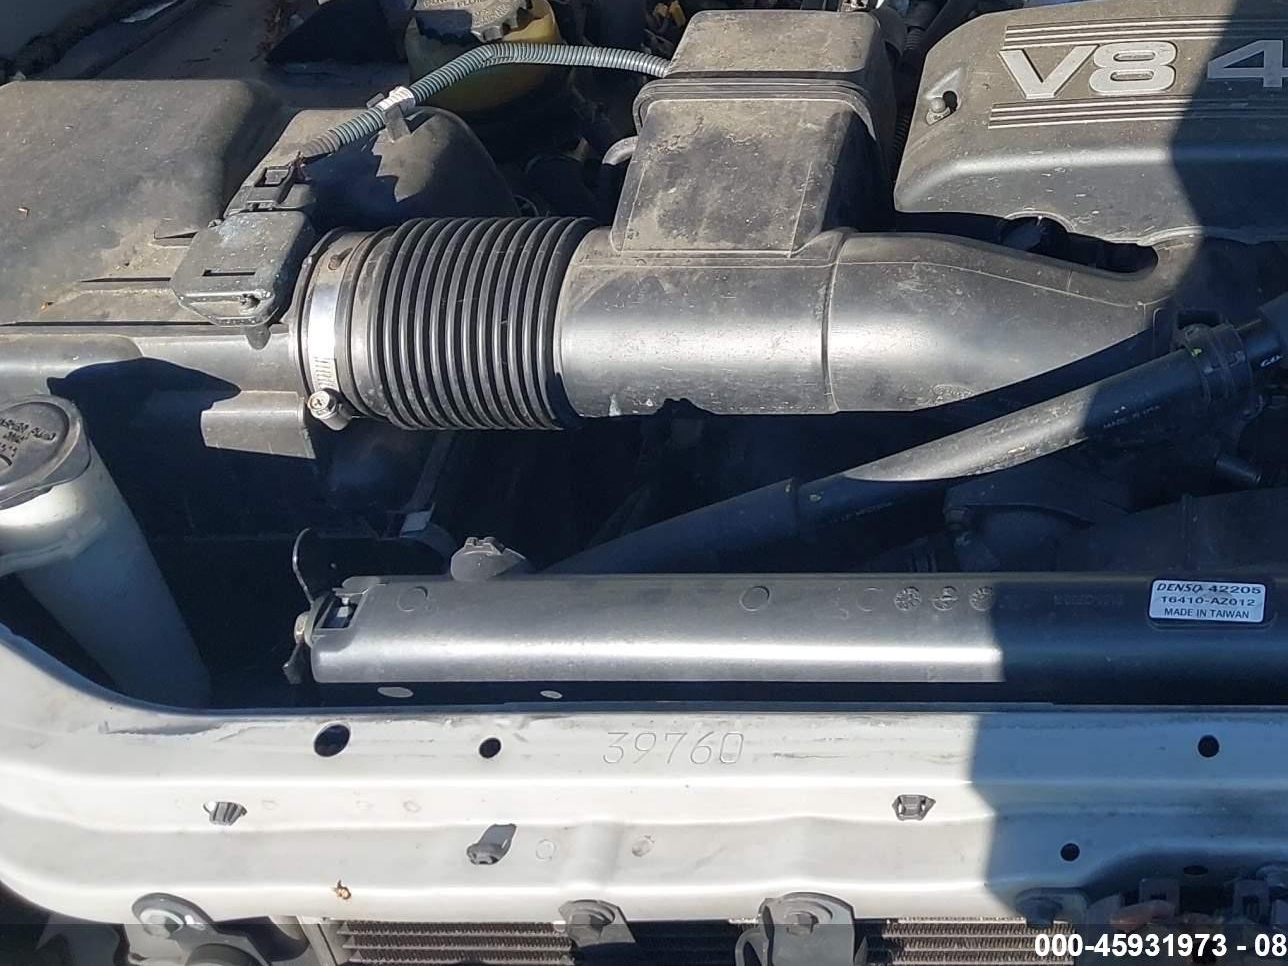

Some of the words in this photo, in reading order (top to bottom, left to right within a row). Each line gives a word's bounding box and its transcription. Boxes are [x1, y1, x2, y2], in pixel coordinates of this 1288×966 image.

[999, 40, 1178, 99] V8
[1157, 583, 1202, 593] DENSO
[1208, 585, 1261, 595] 42205
[1161, 596, 1256, 607] 16410-AZ012
[1164, 608, 1193, 617] MADE
[1196, 609, 1207, 618] IN
[1211, 609, 1249, 619] TAIWAN
[603, 731, 745, 765] 39760
